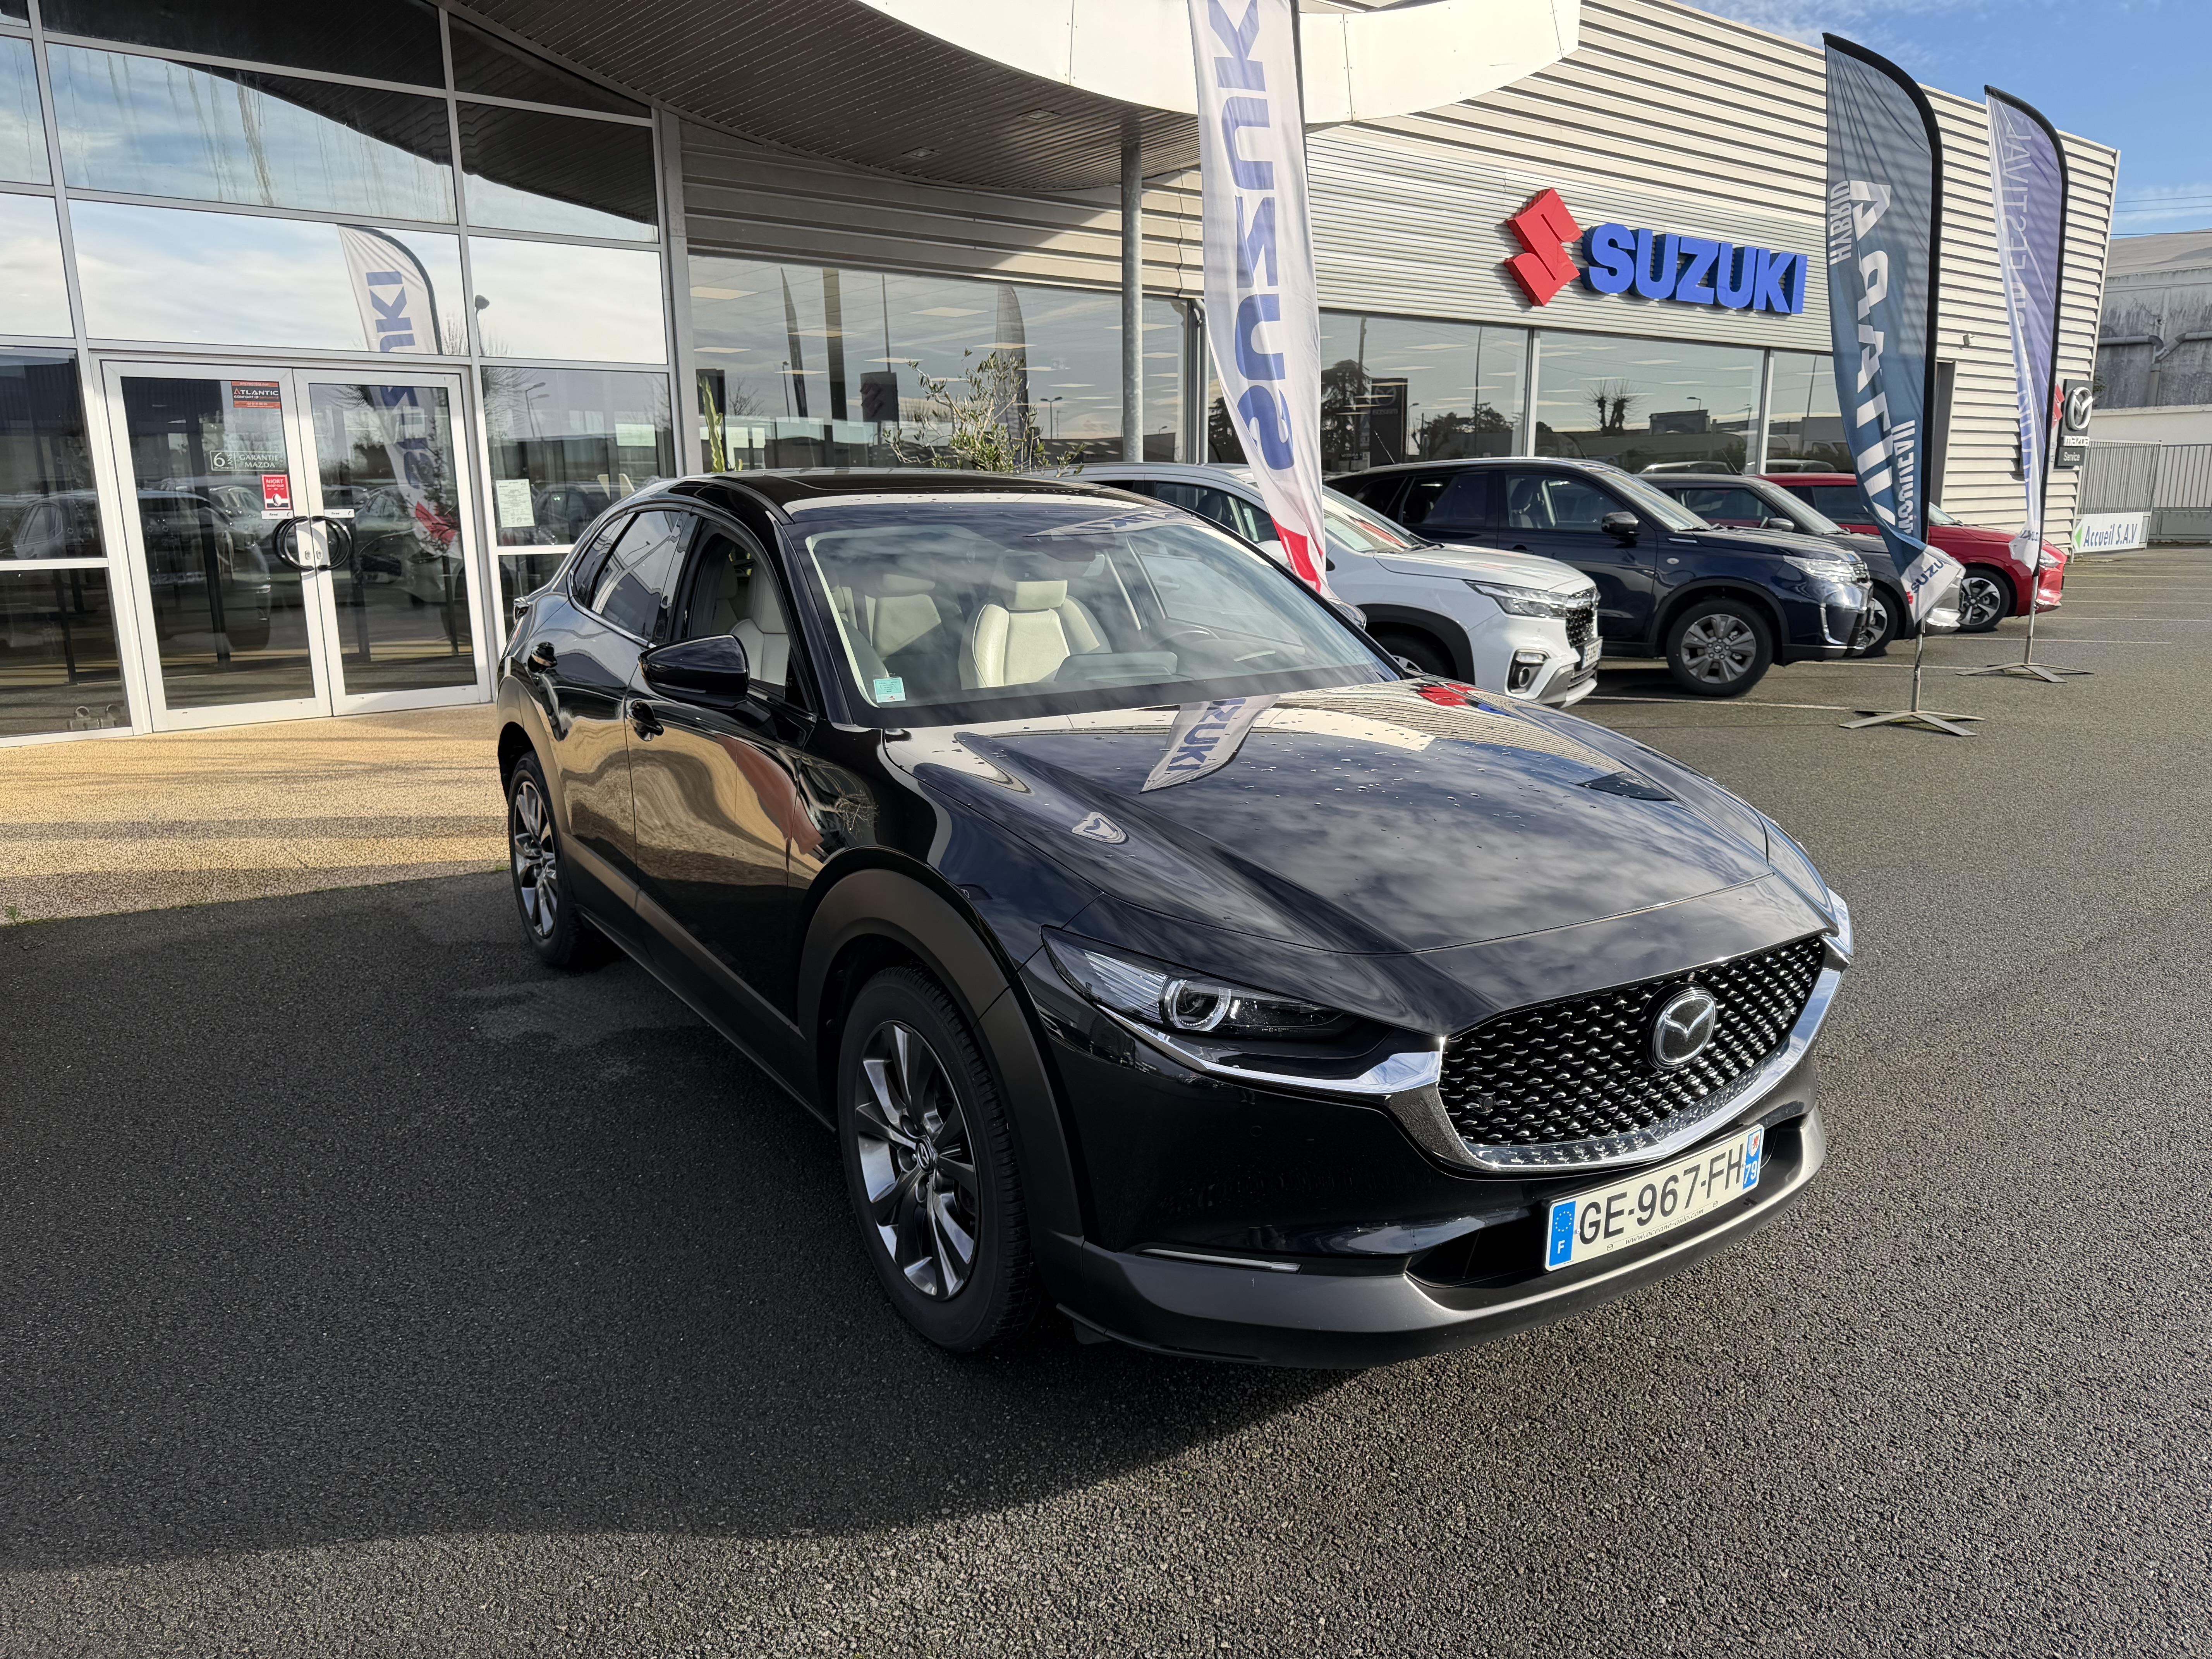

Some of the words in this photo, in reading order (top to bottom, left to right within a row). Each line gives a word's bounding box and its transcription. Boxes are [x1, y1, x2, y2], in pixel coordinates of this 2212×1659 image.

[1582, 223, 1808, 314] SUZUKI
[234, 388, 279, 396] ATLANTIC
[2063, 435, 2090, 446] mazda
[213, 452, 225, 467] 6
[2063, 452, 2080, 461] Service
[2083, 524, 2115, 547] Accueil
[2116, 523, 2138, 545] S.A.V
[1743, 1162, 1757, 1185] 79
[1579, 1144, 1744, 1245] GE-967-FH
[1625, 1209, 1704, 1245] www.oceane-auto.com
[1556, 1240, 1565, 1254] F
